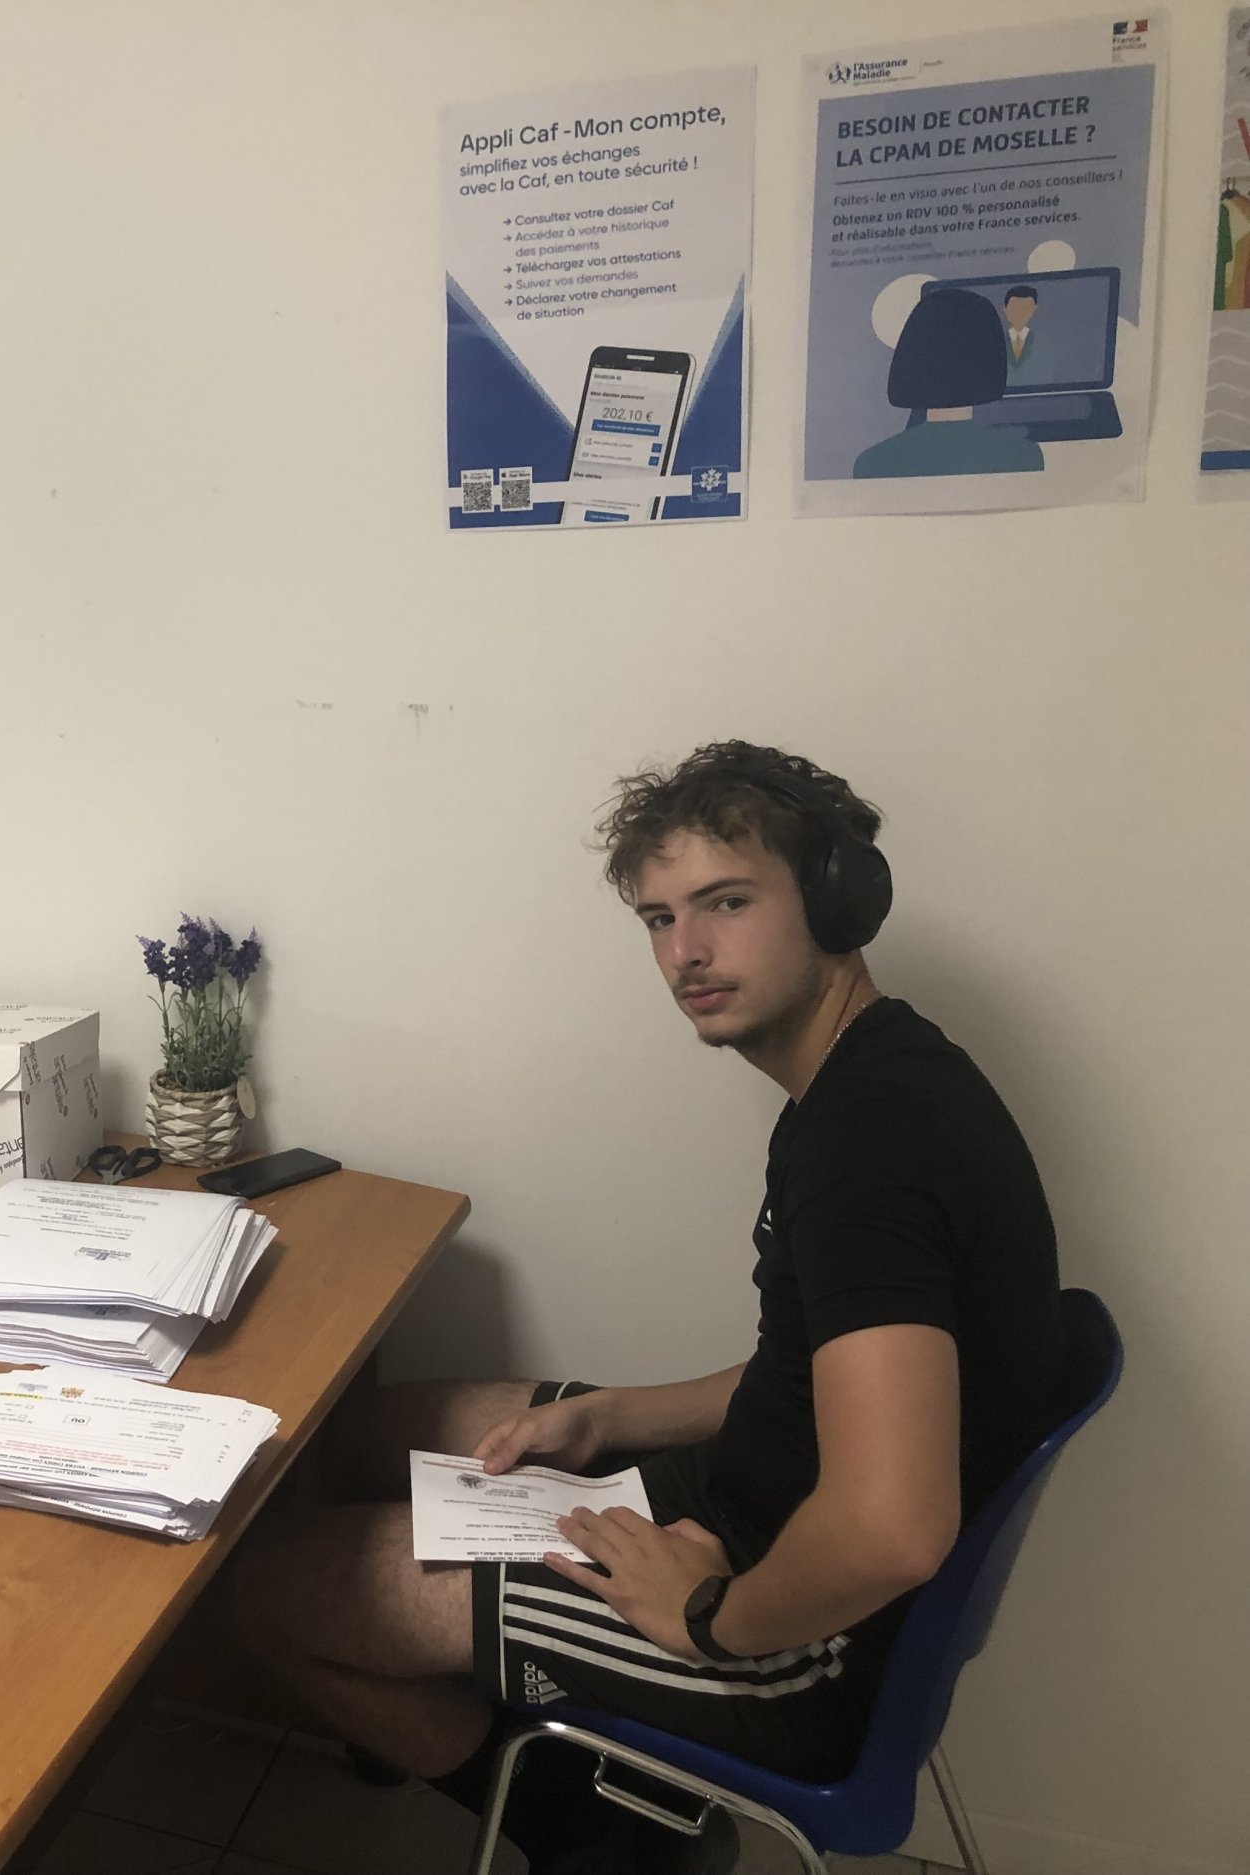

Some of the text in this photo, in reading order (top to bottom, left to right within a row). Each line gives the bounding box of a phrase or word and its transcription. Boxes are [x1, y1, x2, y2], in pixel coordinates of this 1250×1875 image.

[854, 59, 908, 70] l'Assurance
[854, 70, 890, 80] Maladie
[460, 129, 512, 155] Appli
[519, 122, 558, 145] Caf
[575, 118, 623, 138] Mon
[630, 105, 726, 131] compte,
[838, 96, 1090, 139] BESOIN DE CONTACTER
[836, 125, 1095, 167] LA CPAM DE MOSELLE ?
[459, 145, 640, 179] simplifiez vos échanges
[459, 157, 698, 196] avec la Caf, en toute sécurité !
[834, 191, 886, 207] Faites-le
[890, 190, 905, 201] en
[909, 186, 937, 199] visio
[941, 184, 968, 197] avec
[973, 180, 996, 193] l'un
[1000, 179, 1015, 190] de
[1019, 177, 1041, 189] nos
[1046, 170, 1115, 187] conseillers
[515, 200, 674, 226] Consultez votre dossier Caf
[833, 195, 1060, 227] Obtenez un RDV 100 % personnalisé
[515, 217, 670, 242] Accédez à votre historique
[831, 210, 1081, 243] et réalisable dans votre France services.
[515, 240, 600, 258] des paiements
[516, 249, 681, 276] Téléchargez vos attestations
[516, 270, 638, 291] Suivez vos demandes
[516, 283, 677, 307] Déclarez votre changement
[517, 306, 584, 321] de situation
[602, 407, 653, 422] 202,10 €
[524, 1661, 539, 1704] adida
